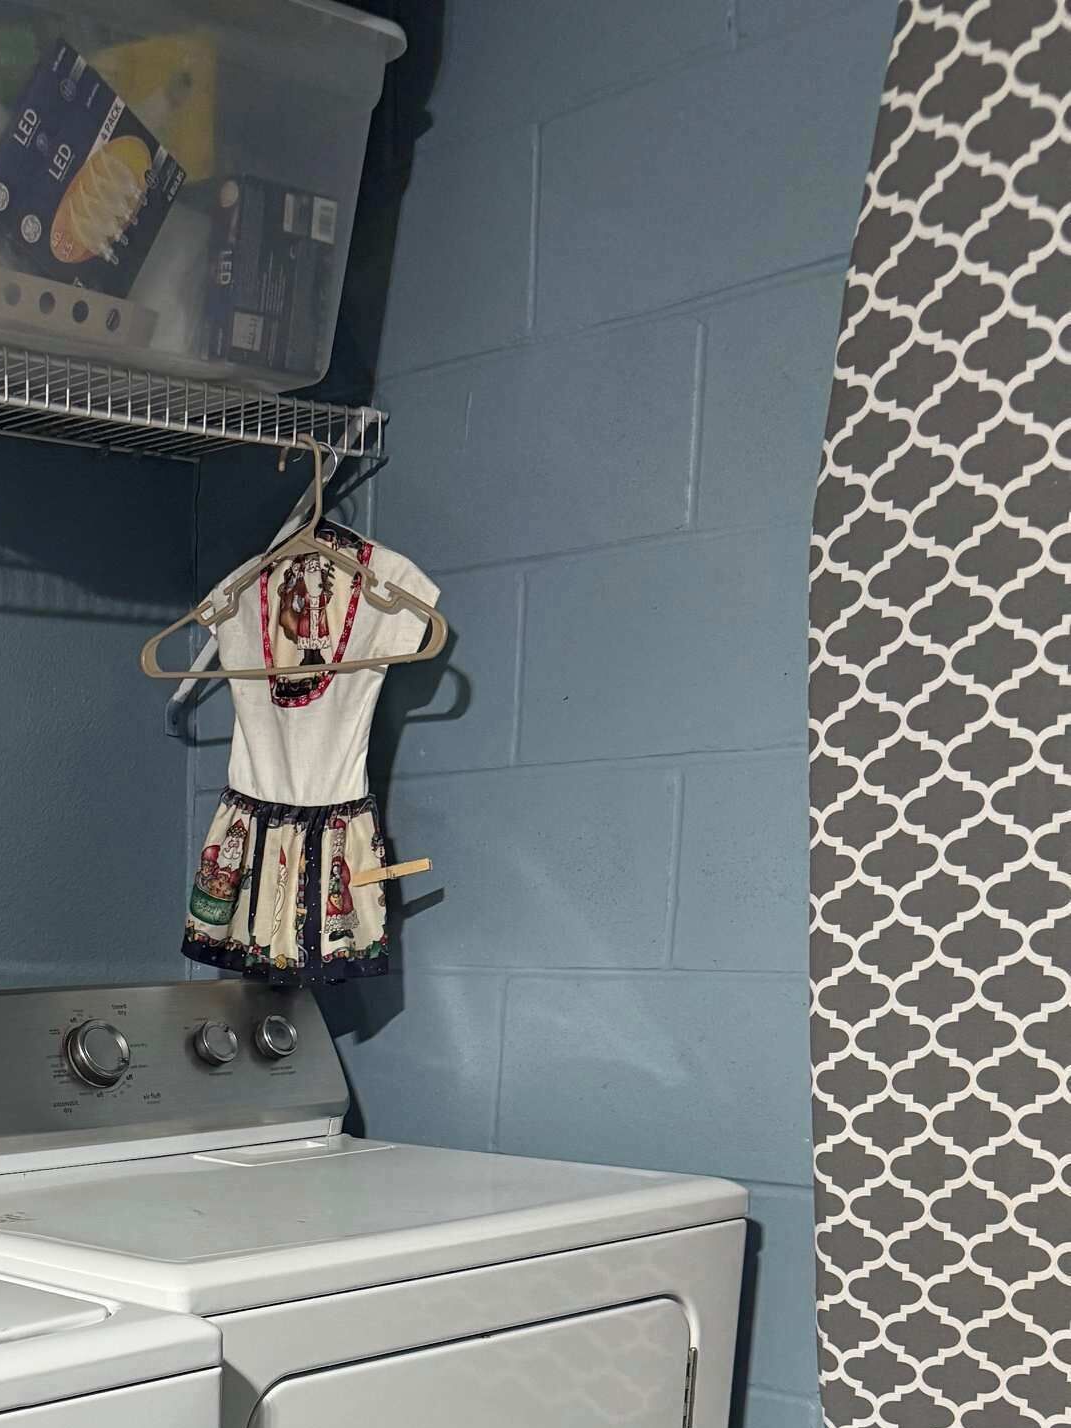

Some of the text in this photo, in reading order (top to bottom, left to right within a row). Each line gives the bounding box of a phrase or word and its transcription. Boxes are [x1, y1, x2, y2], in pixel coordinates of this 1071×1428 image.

[14, 108, 38, 146] LED
[105, 103, 122, 132] PACK
[49, 143, 72, 181] LED
